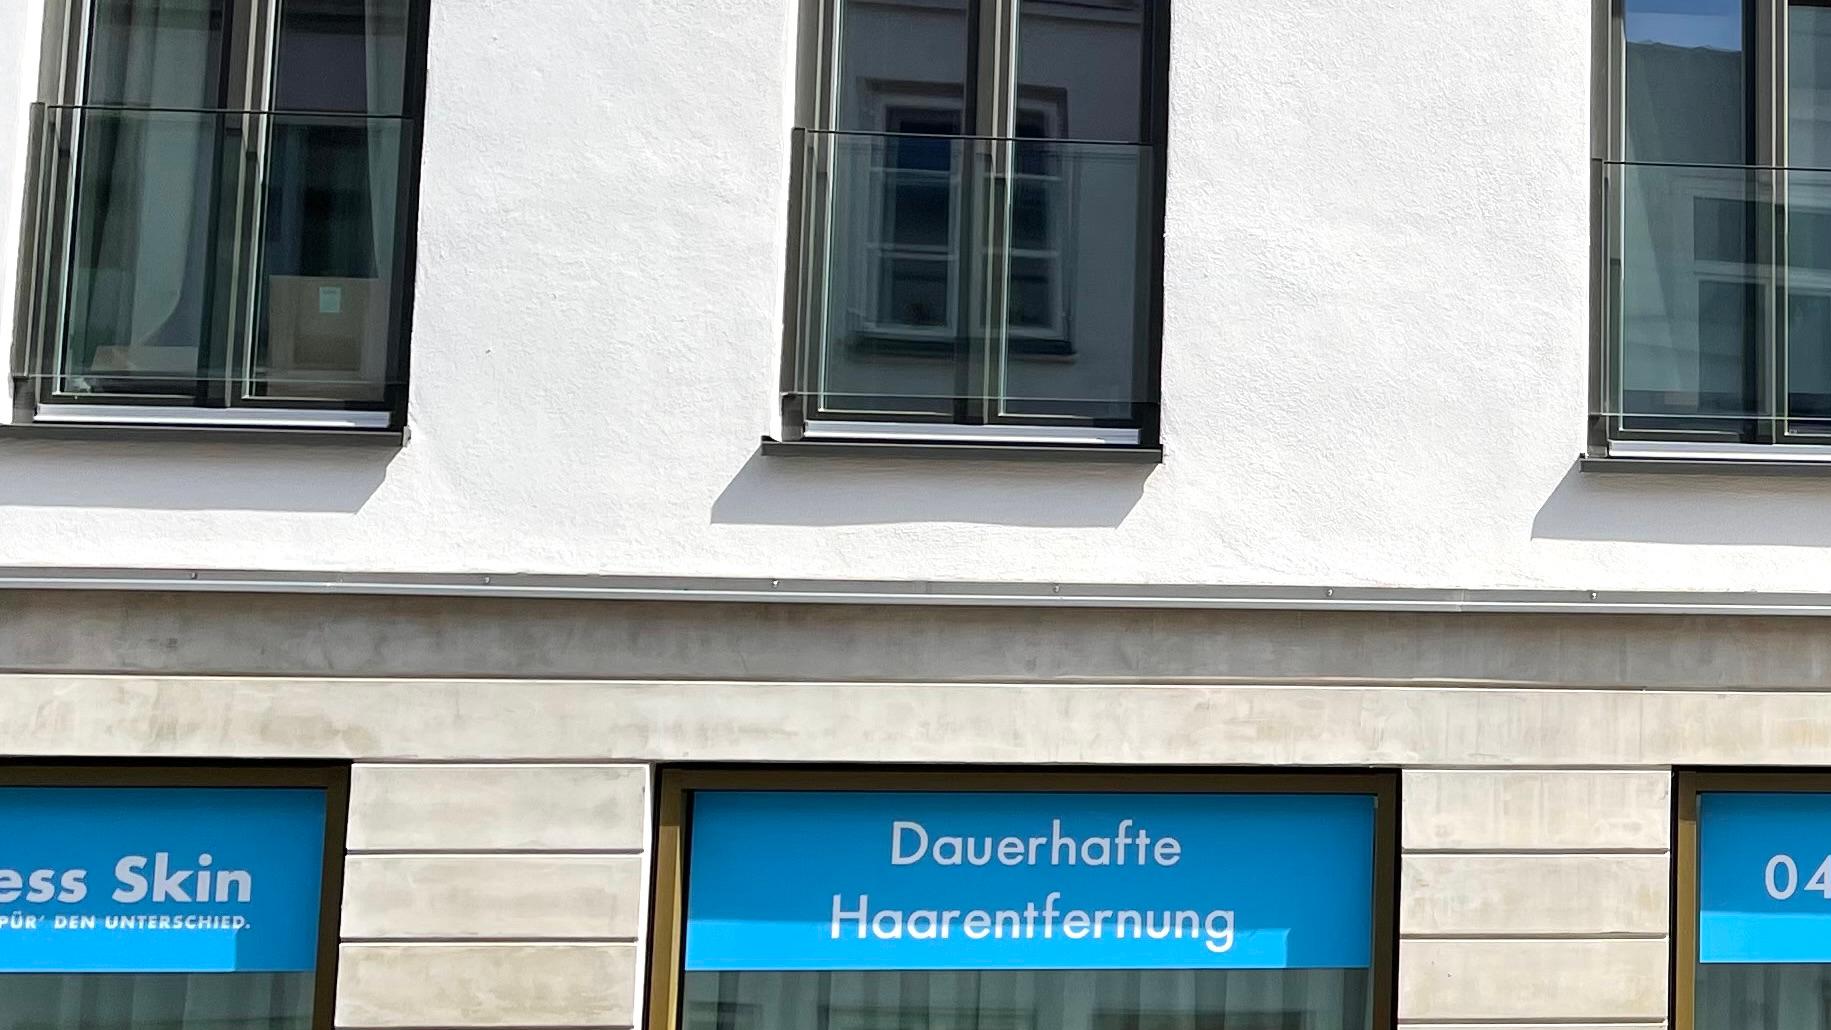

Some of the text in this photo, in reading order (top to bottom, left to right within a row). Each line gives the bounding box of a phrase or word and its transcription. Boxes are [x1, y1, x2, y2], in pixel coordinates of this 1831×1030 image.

[891, 819, 1181, 866] Dauerhafte
[0, 852, 251, 903] ess Skin
[54, 915, 95, 929] DEN
[105, 915, 251, 929] UNTERSCHIED.
[830, 892, 1235, 952] Haarentfernung
